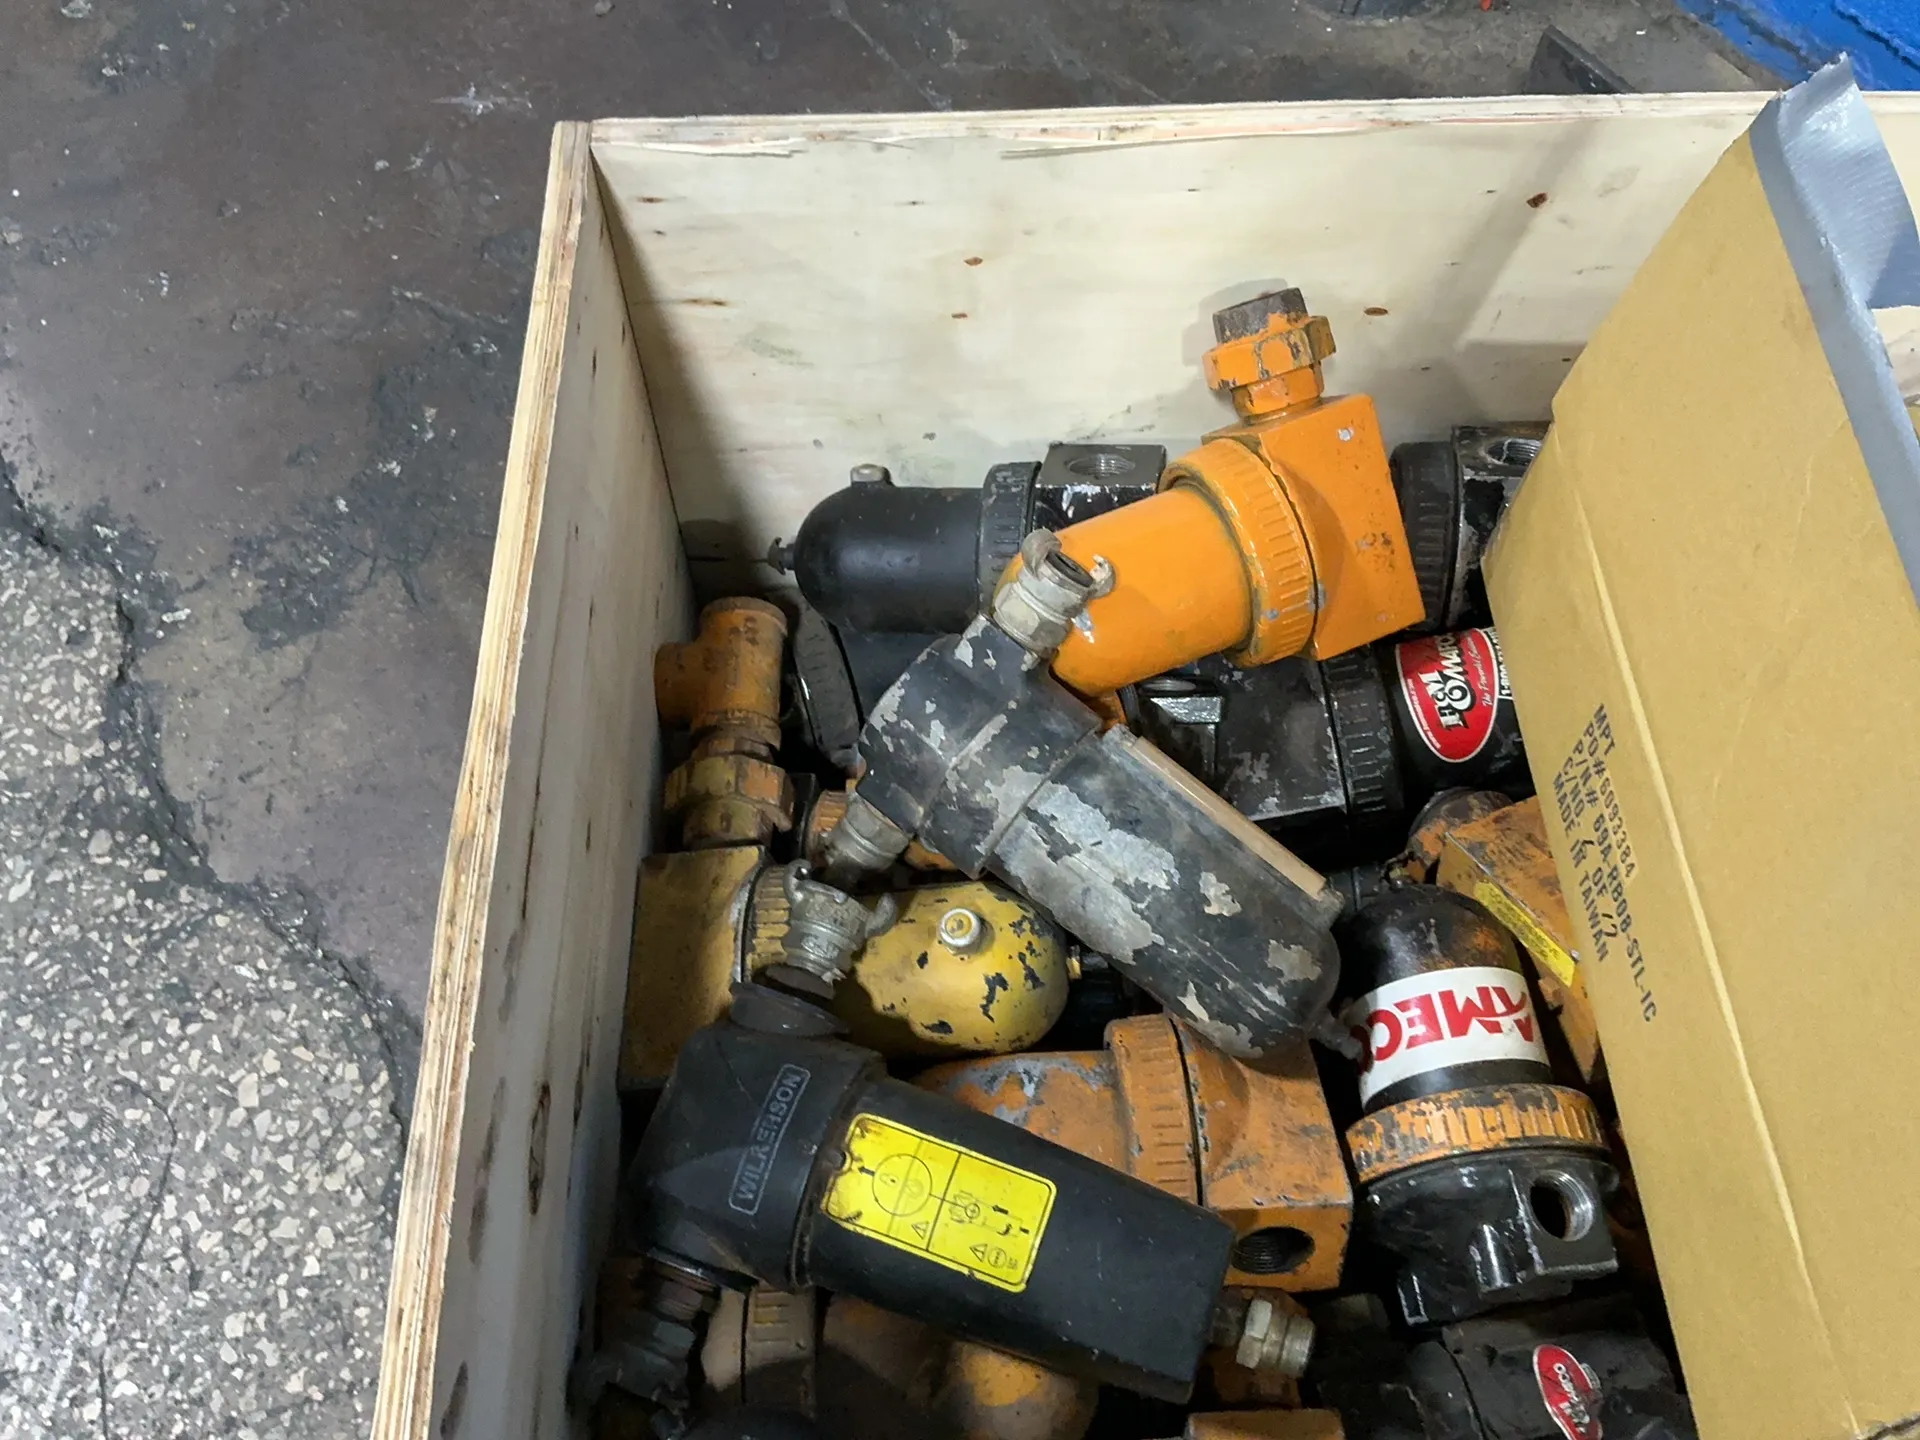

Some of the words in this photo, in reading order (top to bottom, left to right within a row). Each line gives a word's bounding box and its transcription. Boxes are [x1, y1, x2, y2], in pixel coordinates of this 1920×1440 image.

[1594, 703, 1615, 756] MPT
[1573, 739, 1599, 808] P/N#
[1553, 772, 1576, 838] MADE
[1570, 839, 1587, 868] IN
[1579, 870, 1609, 962] TAIWAN
[1592, 867, 1609, 897] OF
[736, 1074, 801, 1200] WILKERSON
